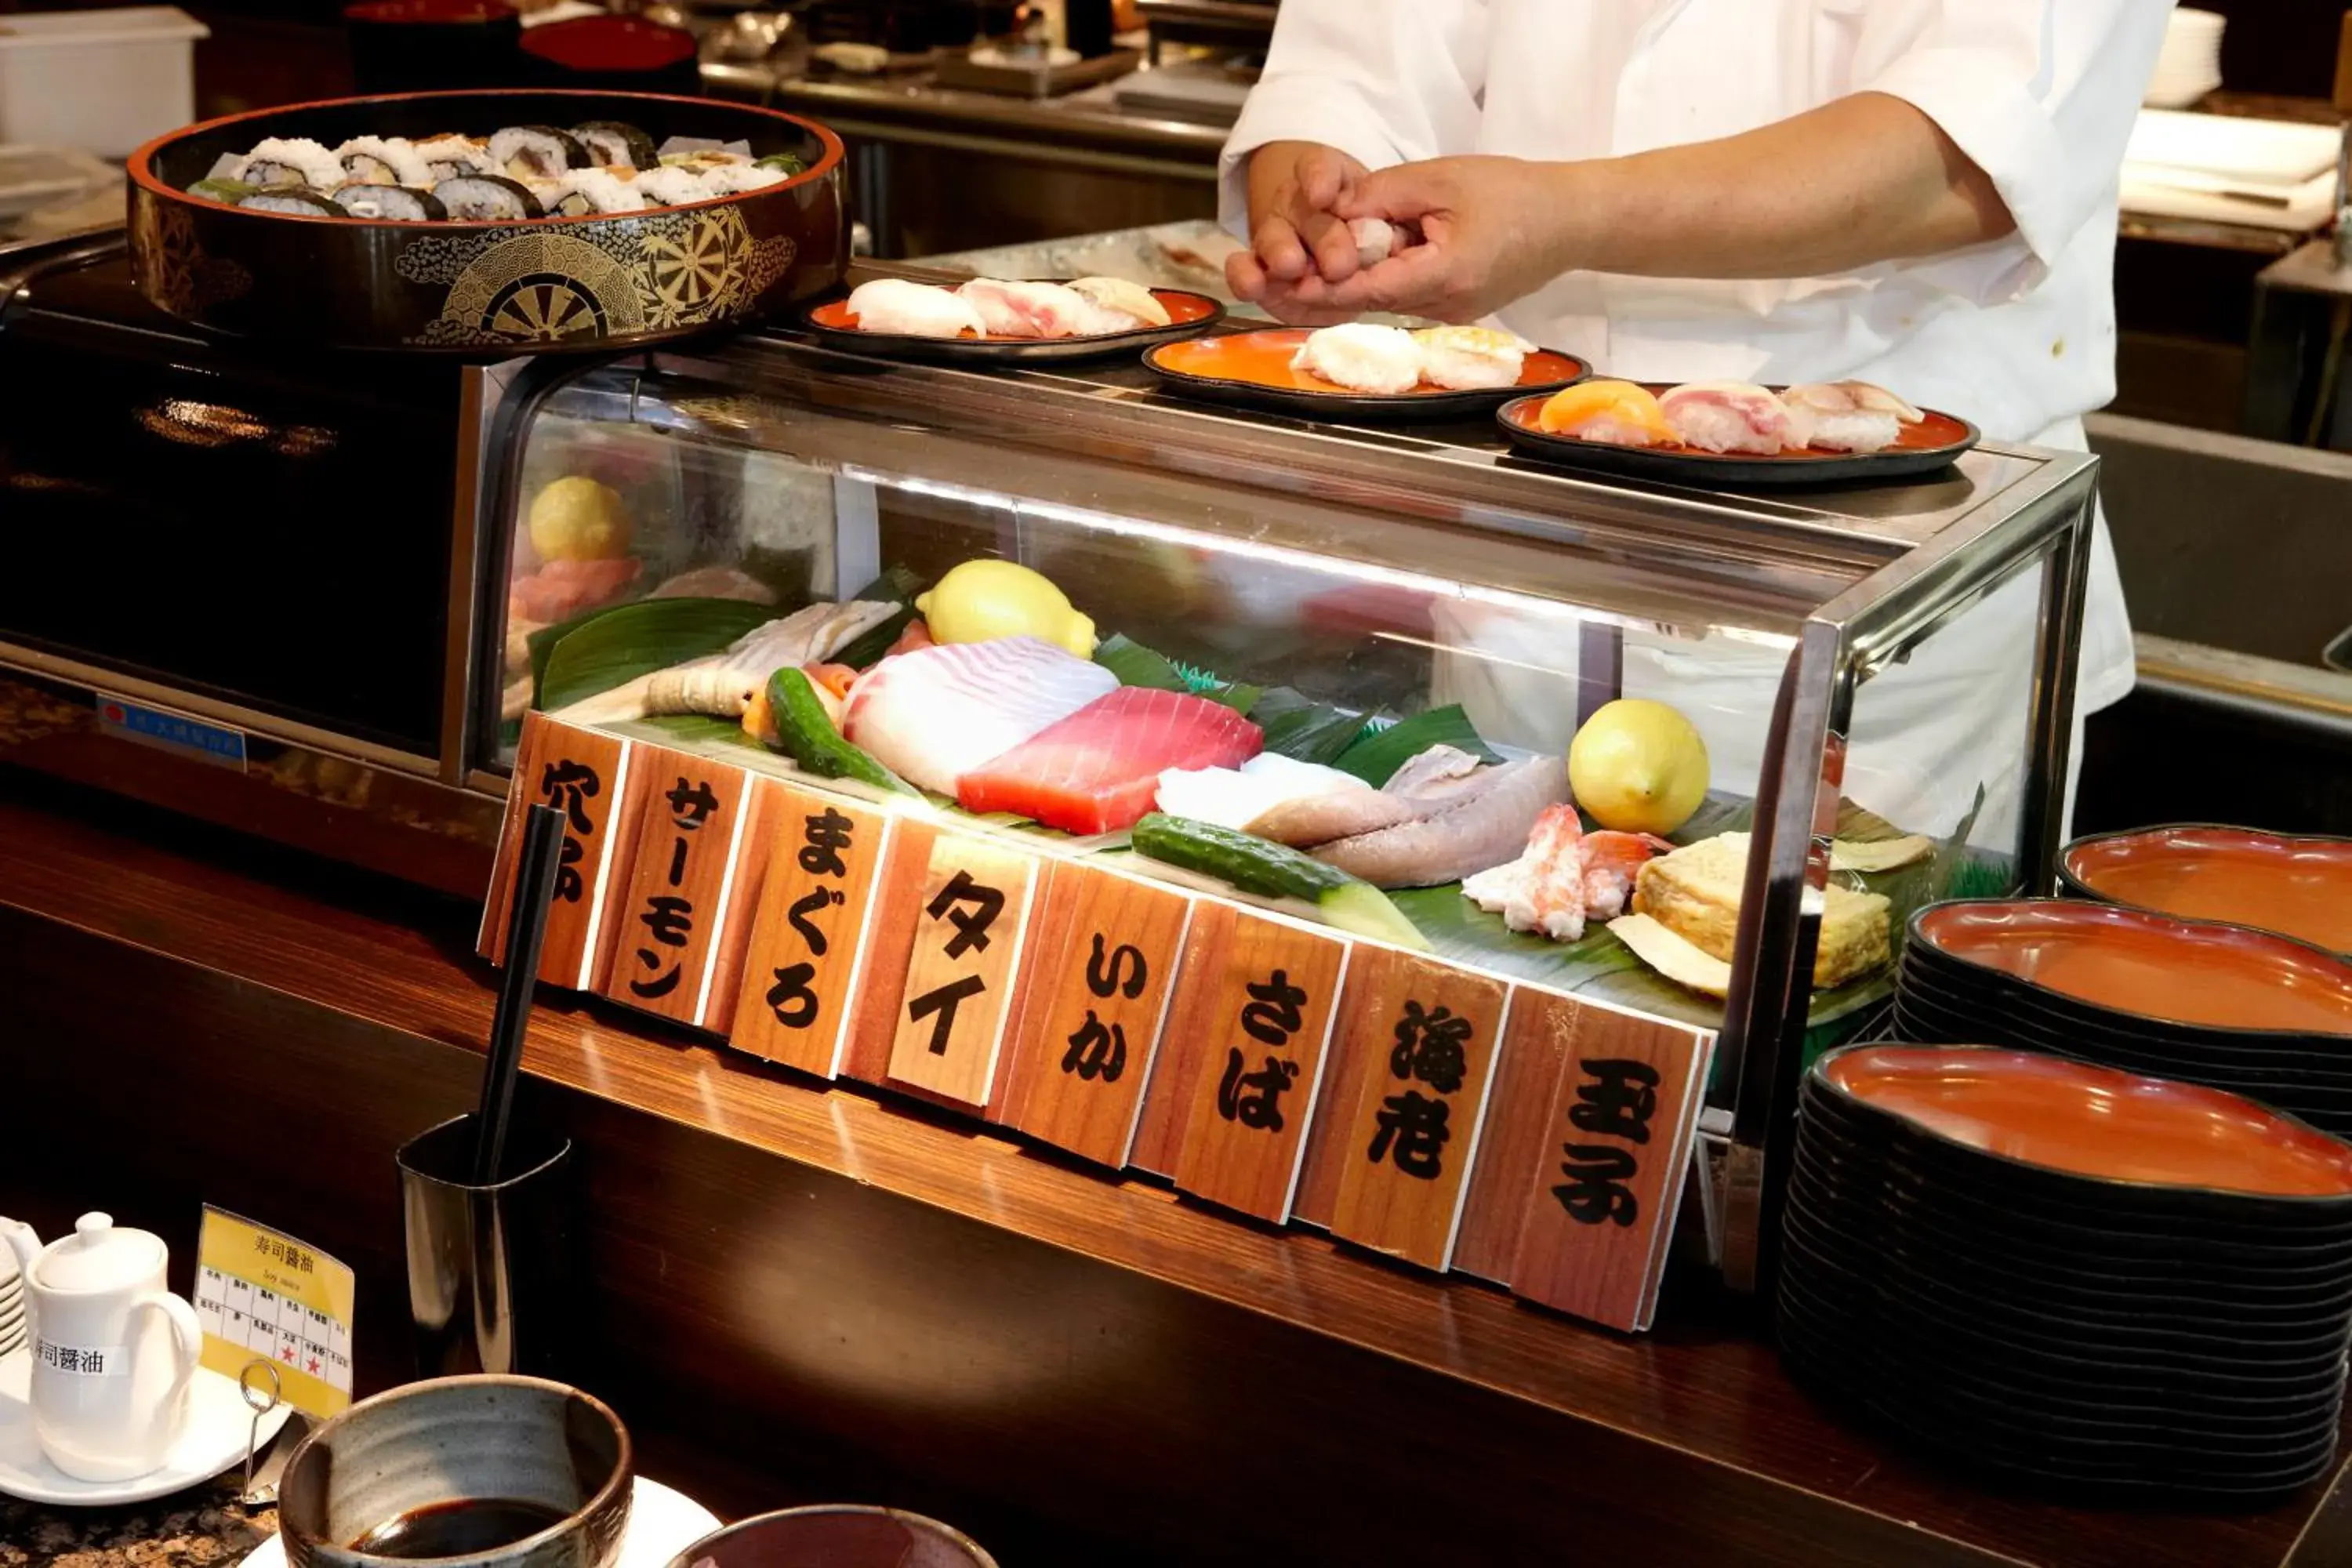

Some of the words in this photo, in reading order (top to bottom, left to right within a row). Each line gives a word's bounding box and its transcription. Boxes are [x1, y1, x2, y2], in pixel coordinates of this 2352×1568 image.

[630, 777, 718, 999] サーモン
[765, 808, 854, 1029] まぐろ
[909, 869, 1005, 1056] タイ
[1062, 933, 1146, 1083] いか
[1218, 970, 1308, 1133] さば
[1367, 1000, 1473, 1180] 海老
[1551, 1058, 1661, 1228] 玉子
